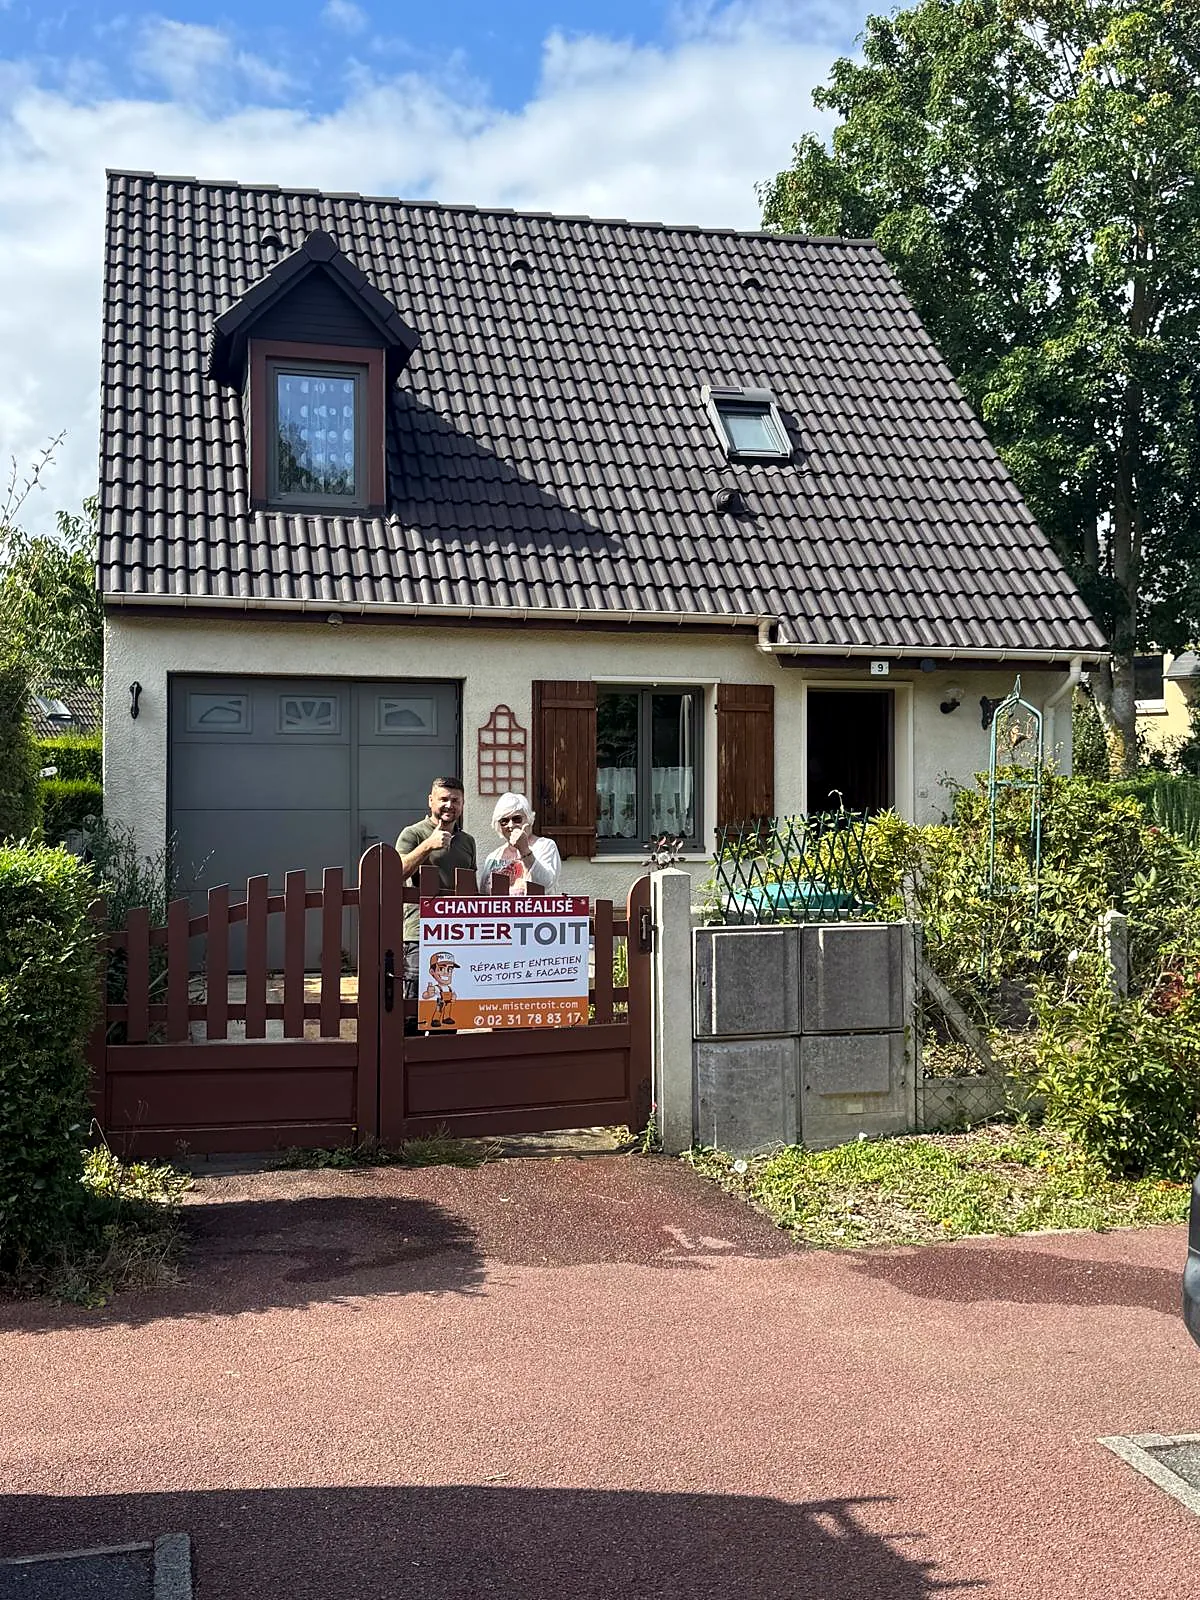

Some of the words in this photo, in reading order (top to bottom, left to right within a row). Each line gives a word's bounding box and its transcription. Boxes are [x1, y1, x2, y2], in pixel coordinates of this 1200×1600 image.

[877, 663, 884, 673] 9
[434, 900, 511, 914] CHANTIER
[514, 898, 573, 913] RÉALISÉ
[423, 923, 512, 941] MISTER
[514, 922, 587, 945] TOIT
[470, 961, 510, 972] RÉPARE
[514, 960, 525, 969] ET
[529, 955, 582, 967] ENTRETIEN
[474, 974, 492, 982] VOS
[496, 972, 522, 980] TOITS
[536, 966, 578, 975] FACADES
[479, 1001, 578, 1011] www.mistertoit.com
[487, 1015, 502, 1026] 02
[507, 1014, 521, 1025] 31
[527, 1013, 542, 1024] 78
[547, 1012, 561, 1024] 83
[567, 1012, 581, 1023] 17
